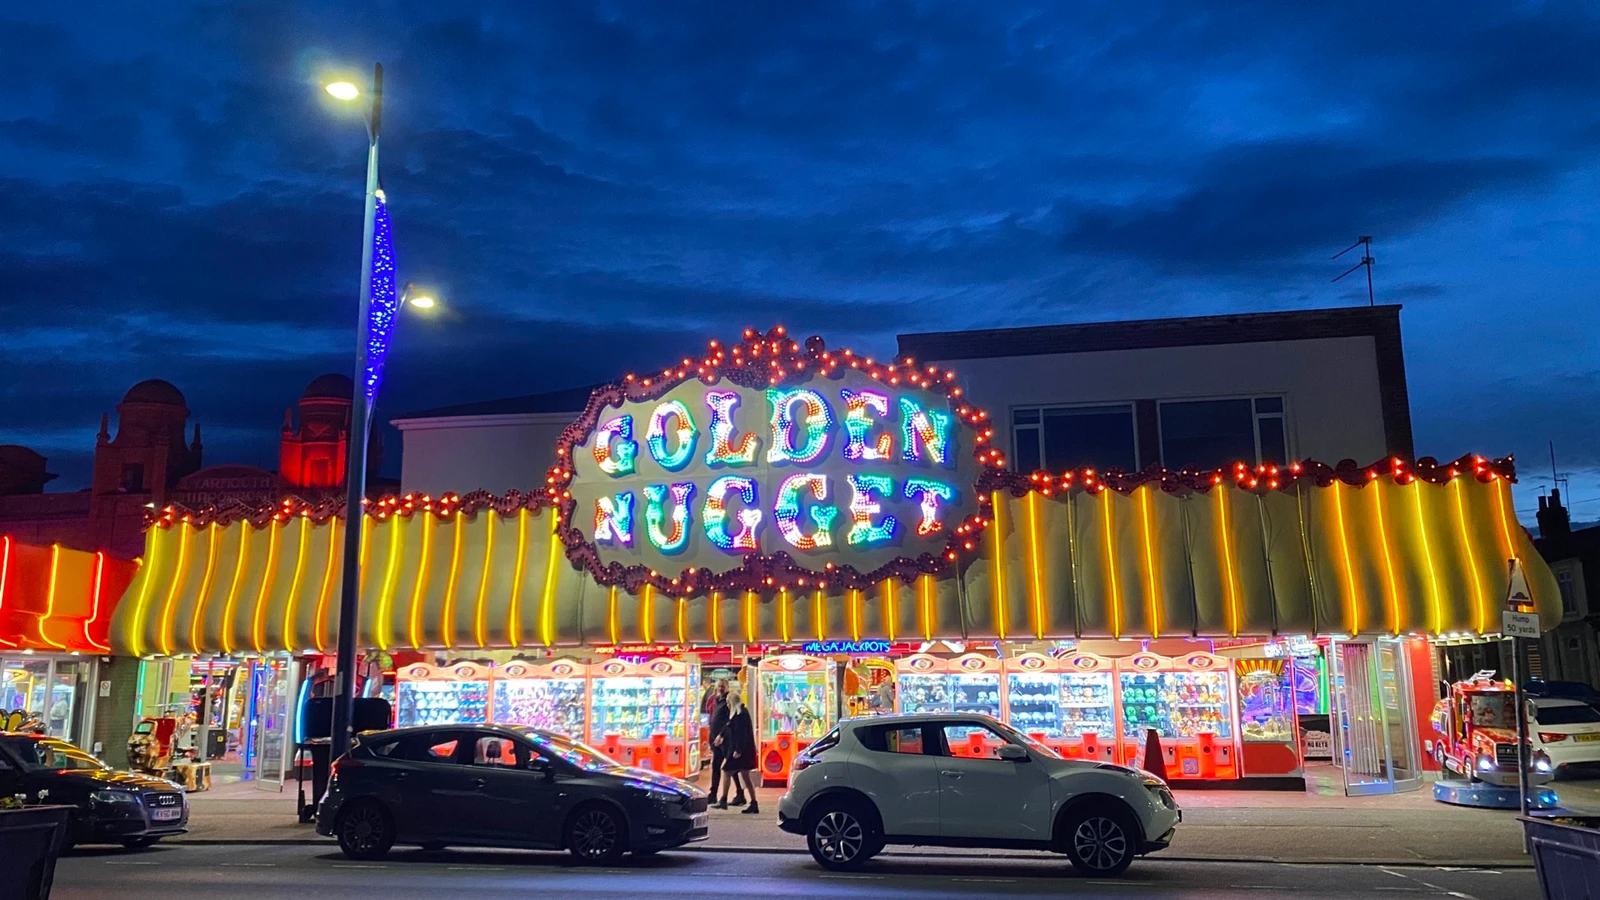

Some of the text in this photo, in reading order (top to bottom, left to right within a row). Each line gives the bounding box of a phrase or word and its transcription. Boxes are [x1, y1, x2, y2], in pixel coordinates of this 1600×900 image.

[594, 388, 951, 474] GOLDEN
[594, 473, 952, 550] NUGGET
[1512, 615, 1529, 623] Hump
[1507, 623, 1536, 634] 50 yards
[805, 642, 890, 652] MEGA JACKPOTS
